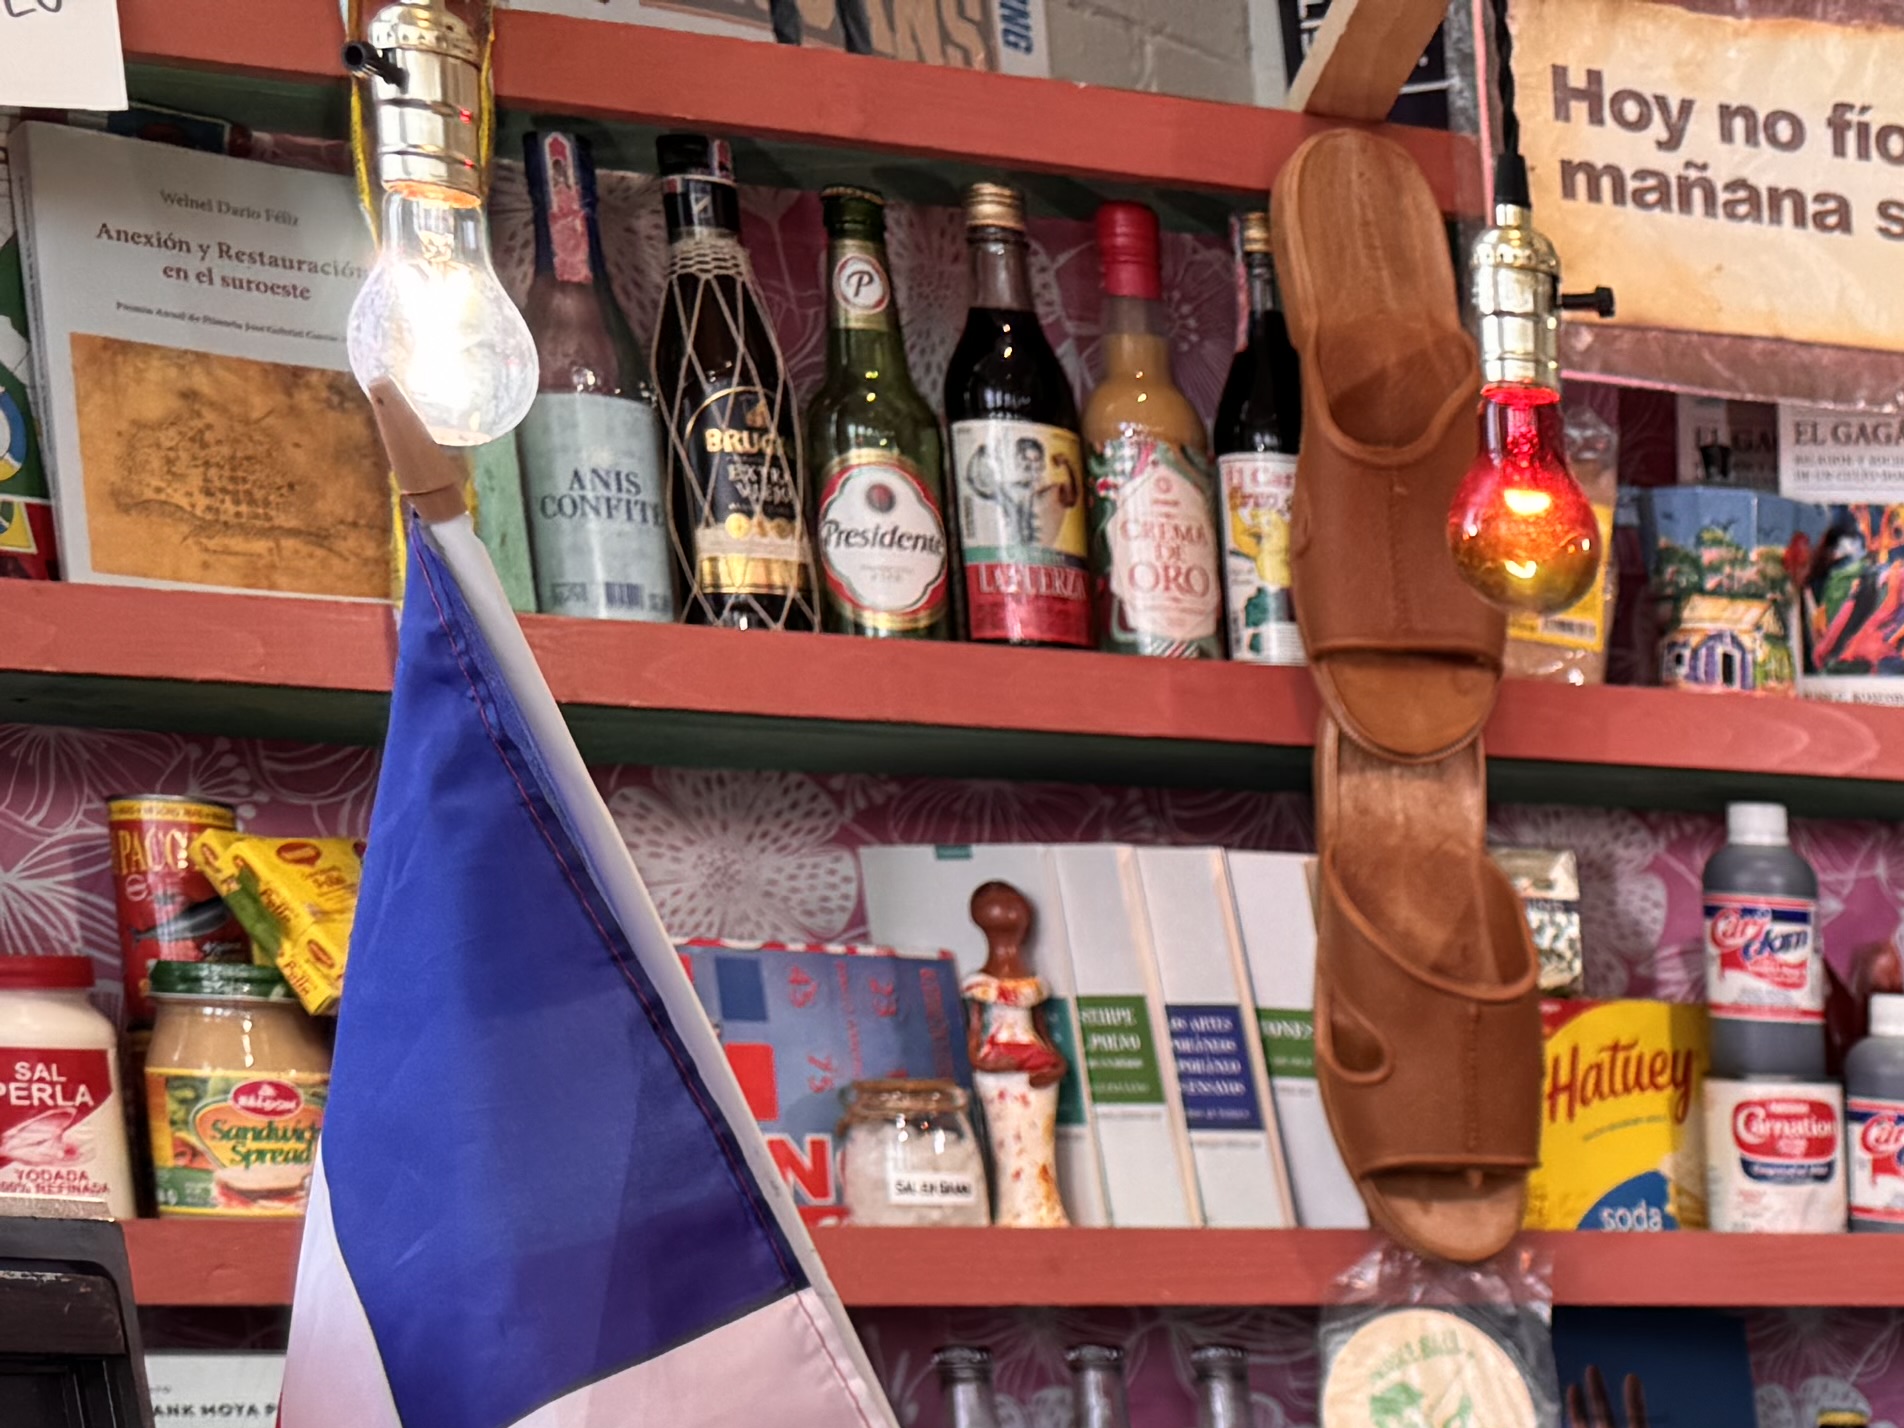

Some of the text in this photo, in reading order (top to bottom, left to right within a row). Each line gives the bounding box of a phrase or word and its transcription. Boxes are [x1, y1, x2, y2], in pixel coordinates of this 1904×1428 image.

[1552, 64, 1695, 150] Hoy
[1719, 101, 1805, 150] no
[1560, 156, 1852, 235] mañana
[97, 223, 370, 280] Anexión y Restauración
[162, 265, 311, 300] en el suroeste
[1794, 423, 1825, 445] EL
[823, 519, 944, 555] Presidente
[1129, 561, 1210, 598] ORO
[15, 1062, 67, 1082] SAL
[1547, 1040, 1694, 1123] Hatuey
[230, 1142, 314, 1170] Spread
[1602, 1200, 1663, 1231] soda
[152, 1404, 259, 1417] ANK MOYA
